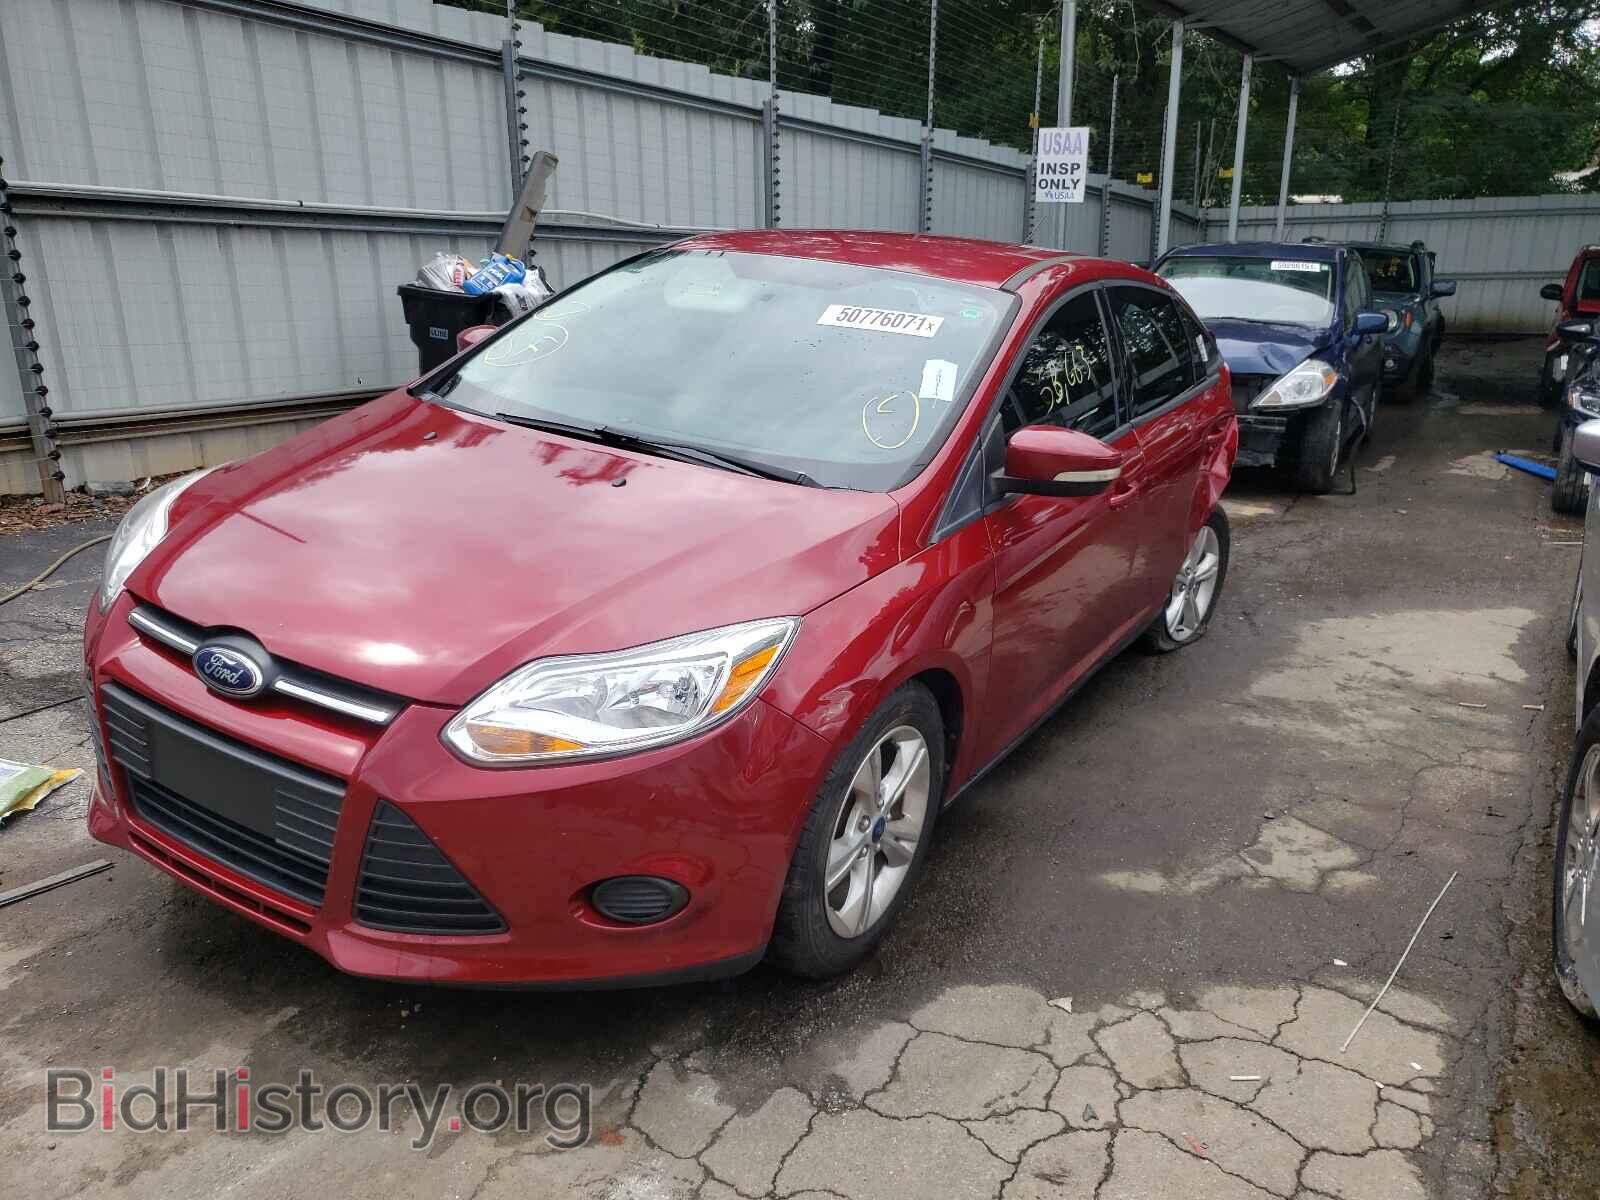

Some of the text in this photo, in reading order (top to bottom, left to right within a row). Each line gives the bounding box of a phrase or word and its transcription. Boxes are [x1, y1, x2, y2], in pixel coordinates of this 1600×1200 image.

[1043, 132, 1082, 155] USAA
[1040, 163, 1081, 175] INSP
[1038, 178, 1081, 190] ONLY
[204, 653, 245, 685] Ford
